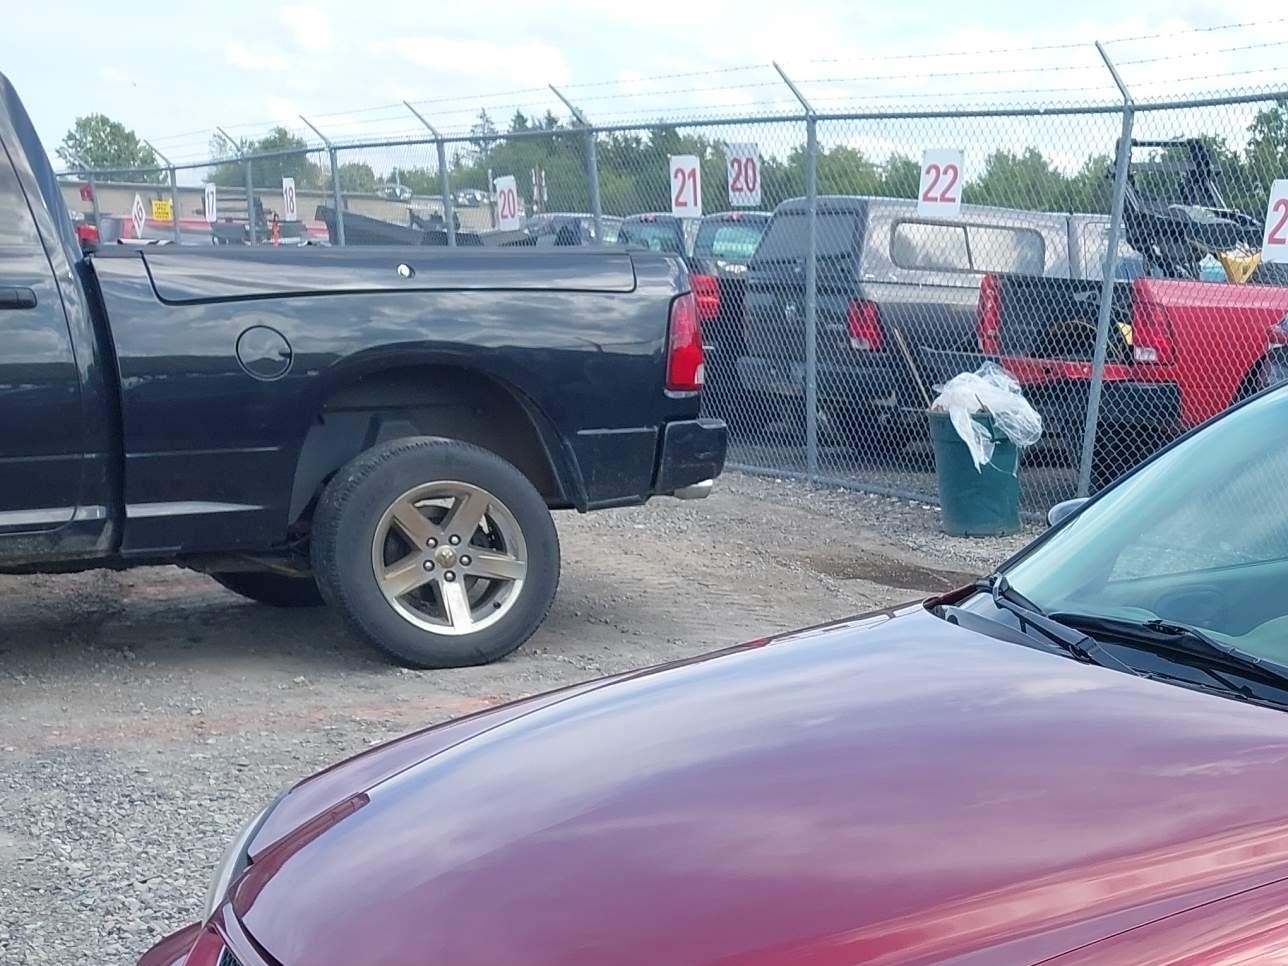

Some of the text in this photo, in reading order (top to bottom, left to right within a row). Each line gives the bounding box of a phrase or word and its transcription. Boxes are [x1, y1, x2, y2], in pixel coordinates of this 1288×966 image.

[674, 168, 698, 207] 21
[730, 158, 757, 193] 20
[921, 163, 959, 203] 22
[206, 188, 215, 217] 17
[284, 189, 295, 215] 18
[500, 188, 517, 219] 20
